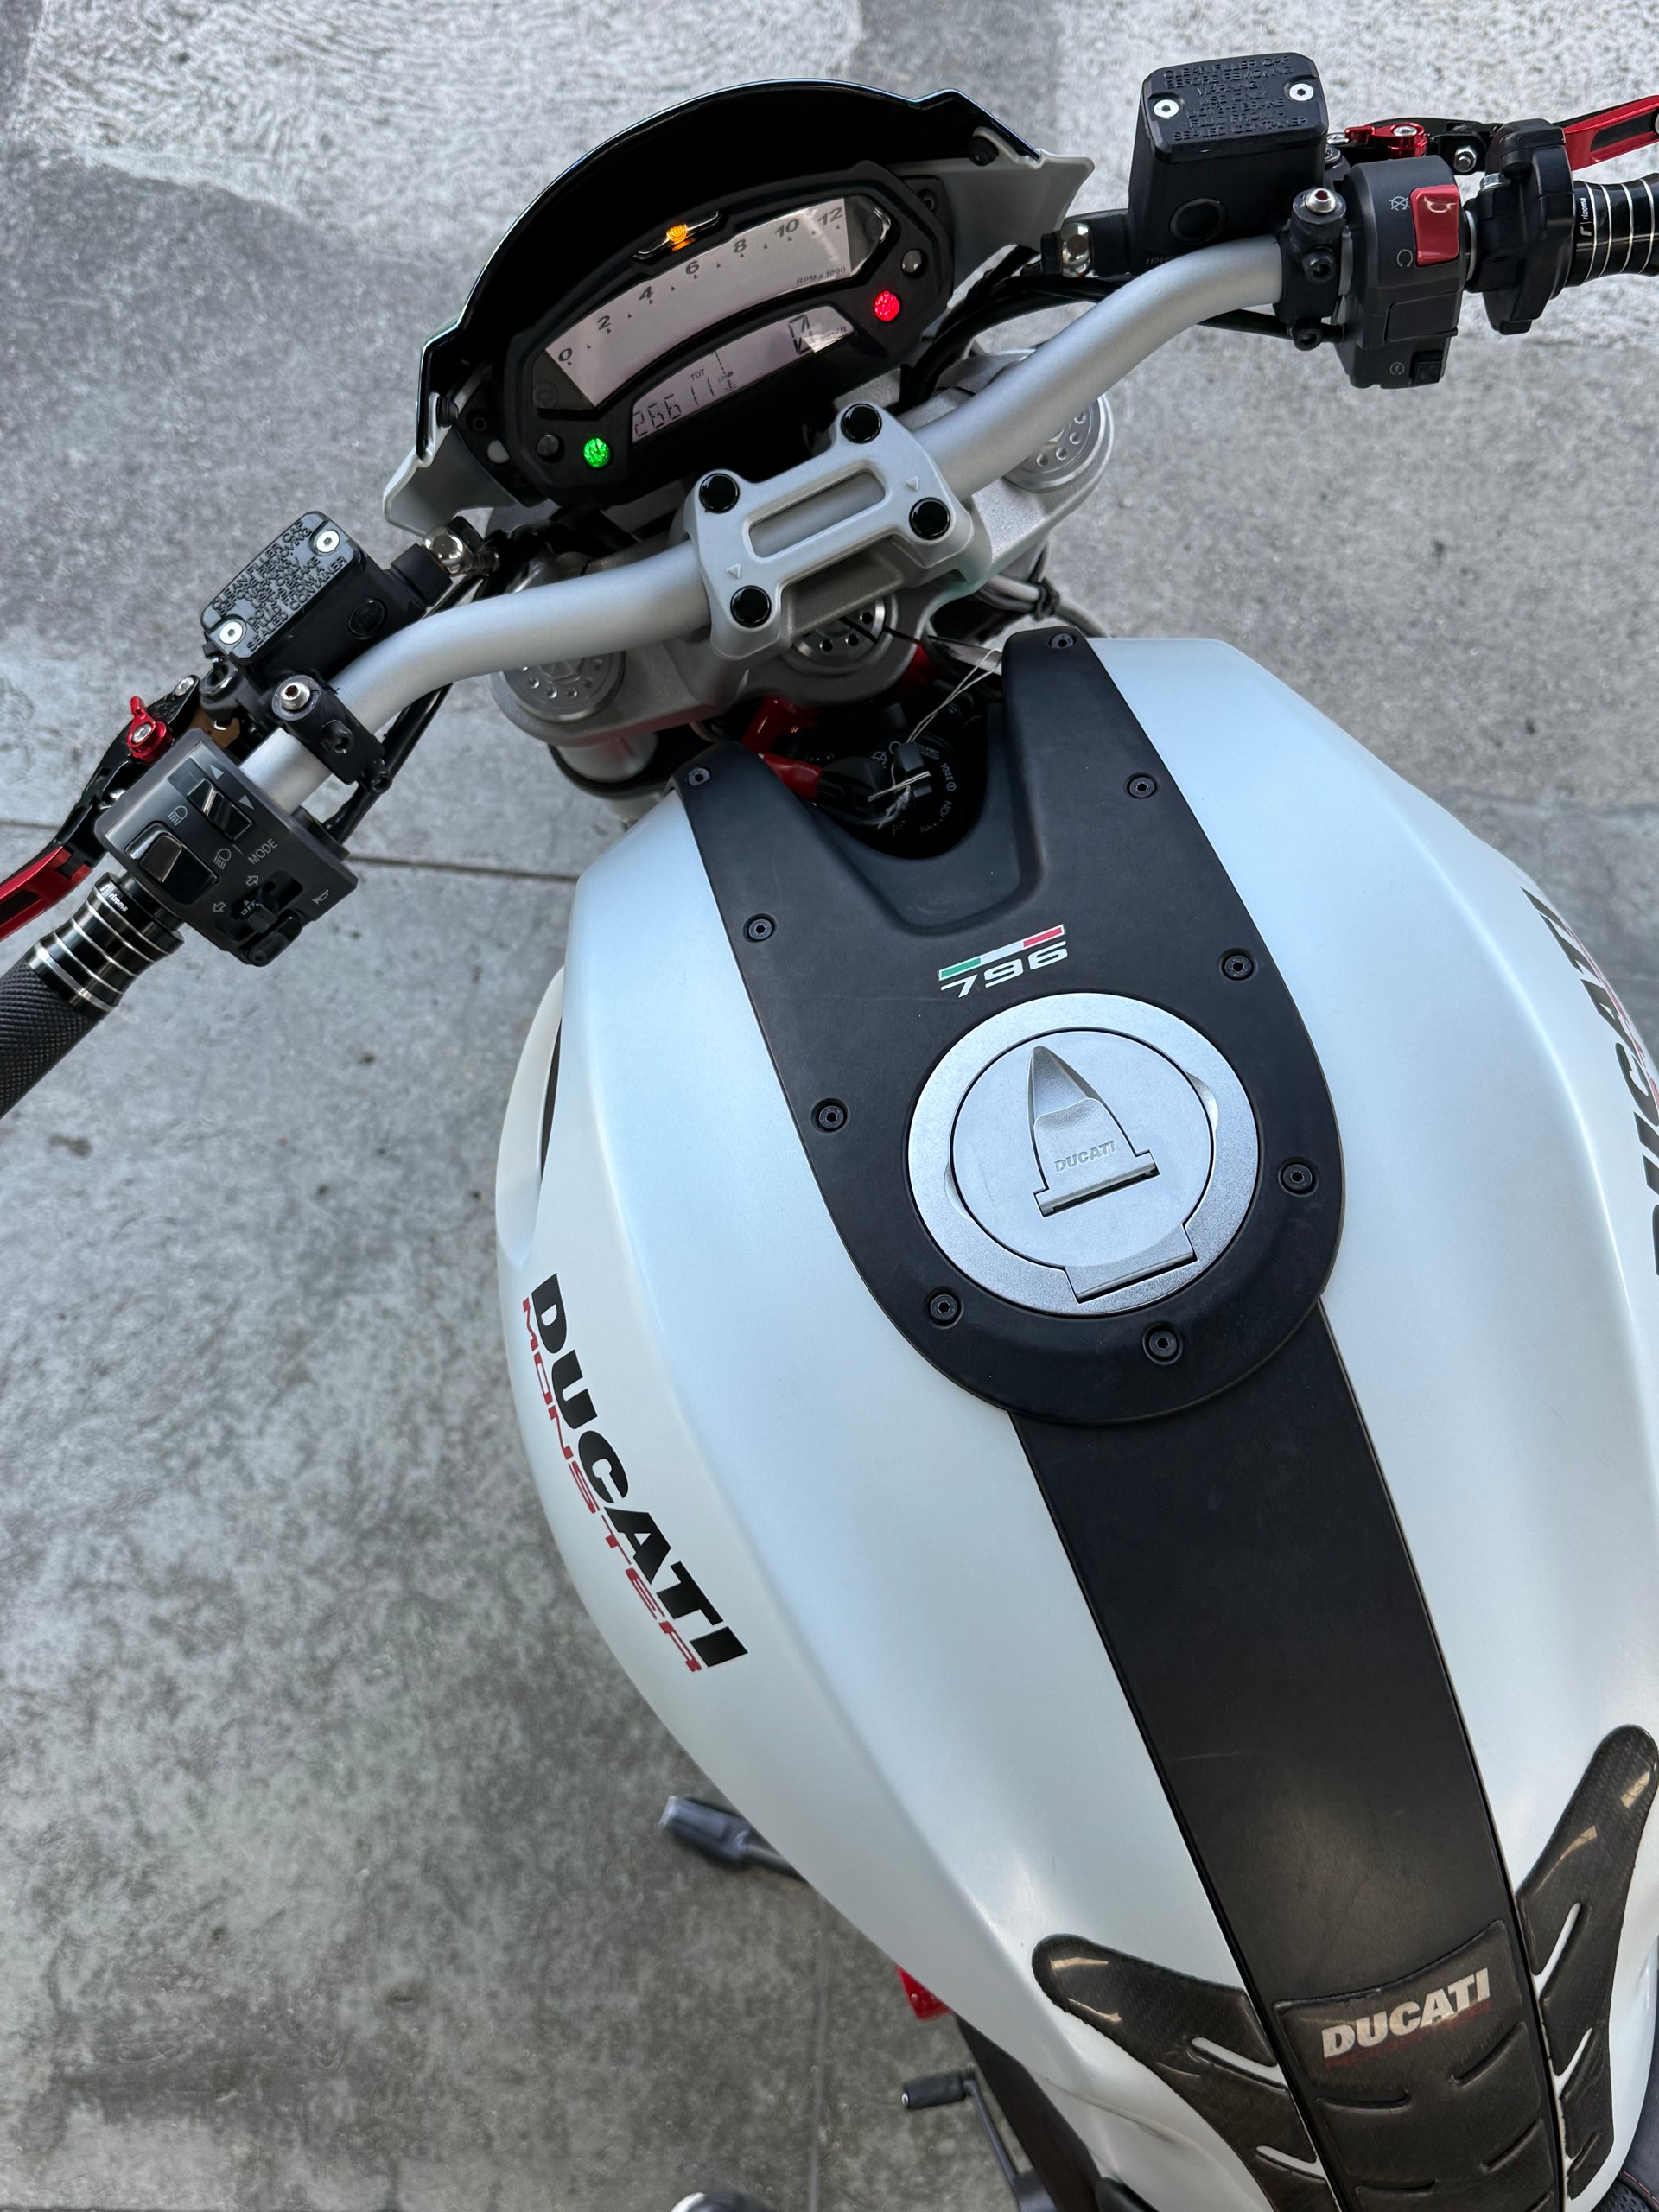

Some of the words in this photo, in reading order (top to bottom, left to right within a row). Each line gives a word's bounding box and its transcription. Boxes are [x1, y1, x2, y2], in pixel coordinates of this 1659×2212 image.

[558, 348, 572, 362] 0
[597, 315, 611, 331] 2
[639, 286, 653, 300] 4
[685, 260, 699, 275] 6
[734, 239, 747, 253] 8
[775, 219, 799, 238] 10
[818, 207, 842, 226] 12
[691, 369, 705, 380] TOT
[211, 575, 247, 609] CLEAN
[247, 543, 281, 576] FILLER
[283, 521, 305, 543] CAP
[217, 578, 257, 616] BEFORE
[258, 527, 311, 576] REMOVING
[286, 557, 319, 588] BRAKE
[246, 611, 288, 650] SEALED
[289, 556, 346, 610] CONTAINER
[251, 588, 273, 608] USE
[253, 605, 282, 632] FLUID
[283, 575, 314, 605] FROM
[248, 838, 278, 865] MODE
[109, 893, 129, 912] rizoma
[941, 941, 1068, 998] 796
[1054, 1141, 1116, 1173] DUCATI
[522, 1297, 702, 1672] MONSTER
[531, 1273, 748, 1668] DUCATI
[1322, 1967, 1491, 2058] DUCATI
